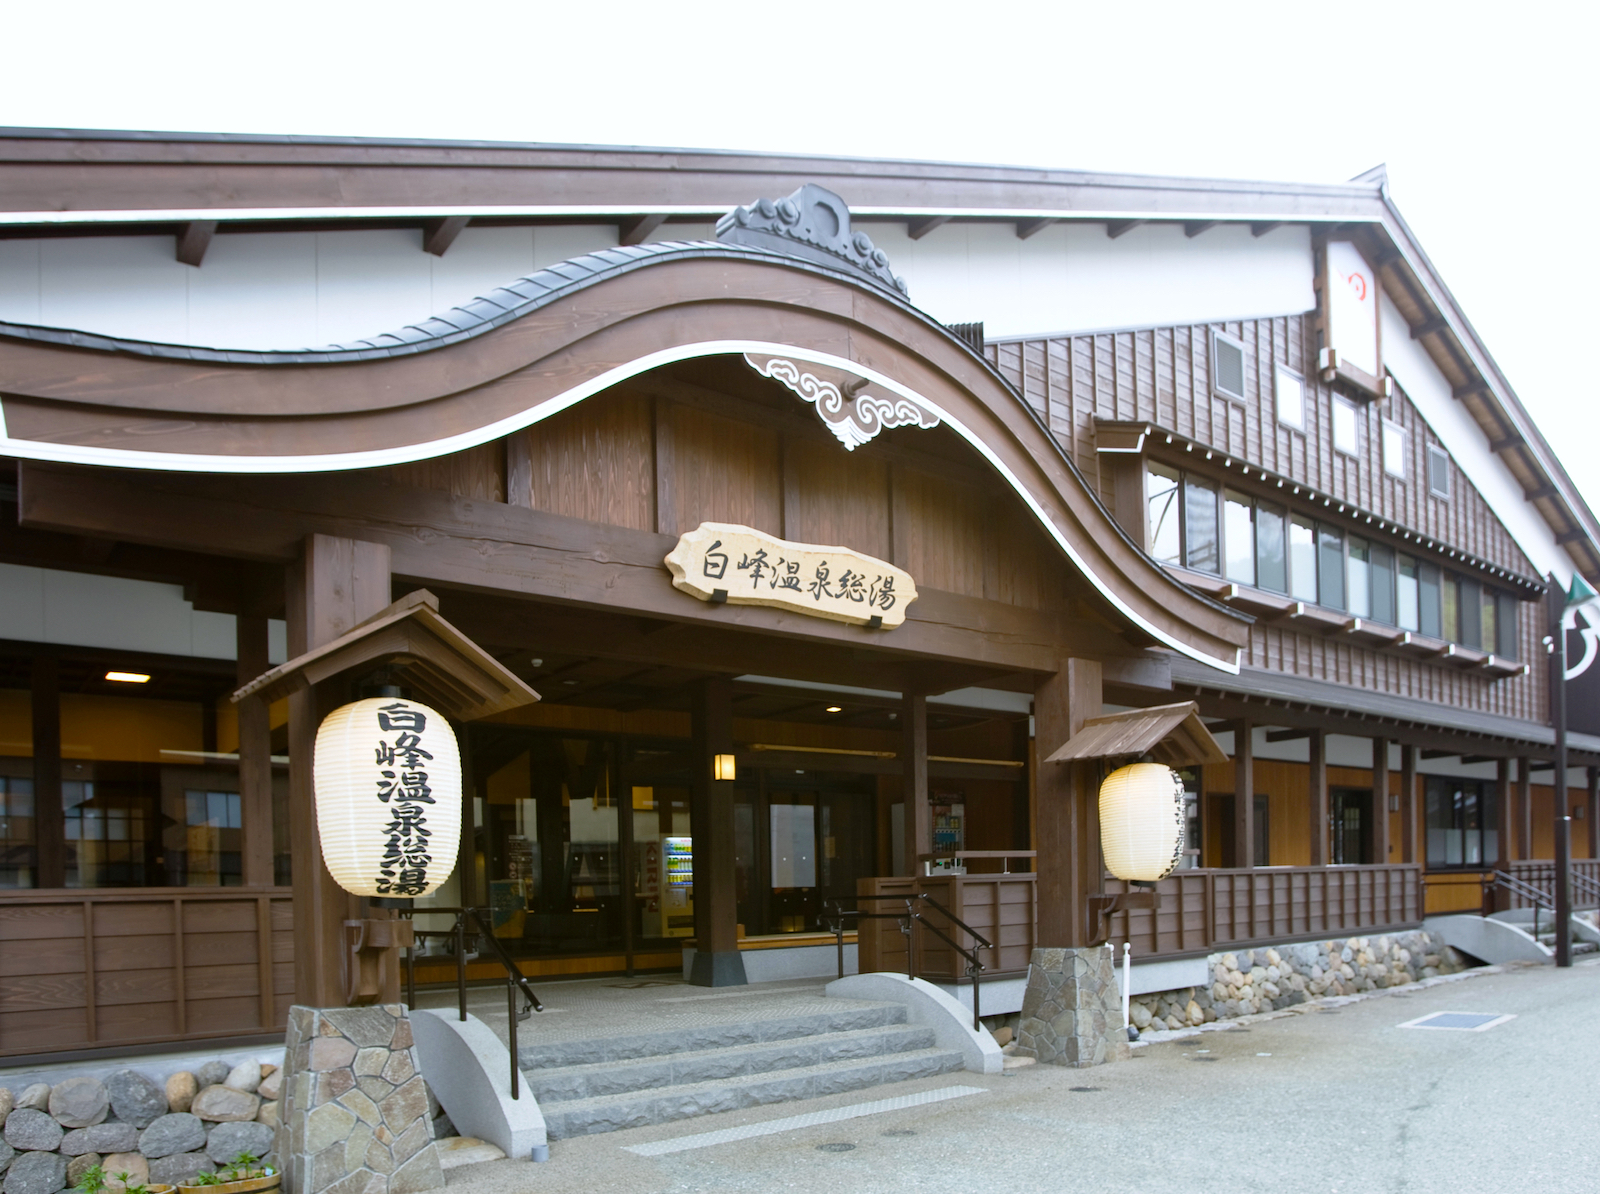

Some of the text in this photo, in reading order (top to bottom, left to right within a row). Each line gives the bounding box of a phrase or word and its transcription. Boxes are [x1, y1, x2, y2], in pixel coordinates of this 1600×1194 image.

[703, 540, 896, 611] 白峰温泉総湯
[375, 703, 436, 896] 白峰温泉総湯
